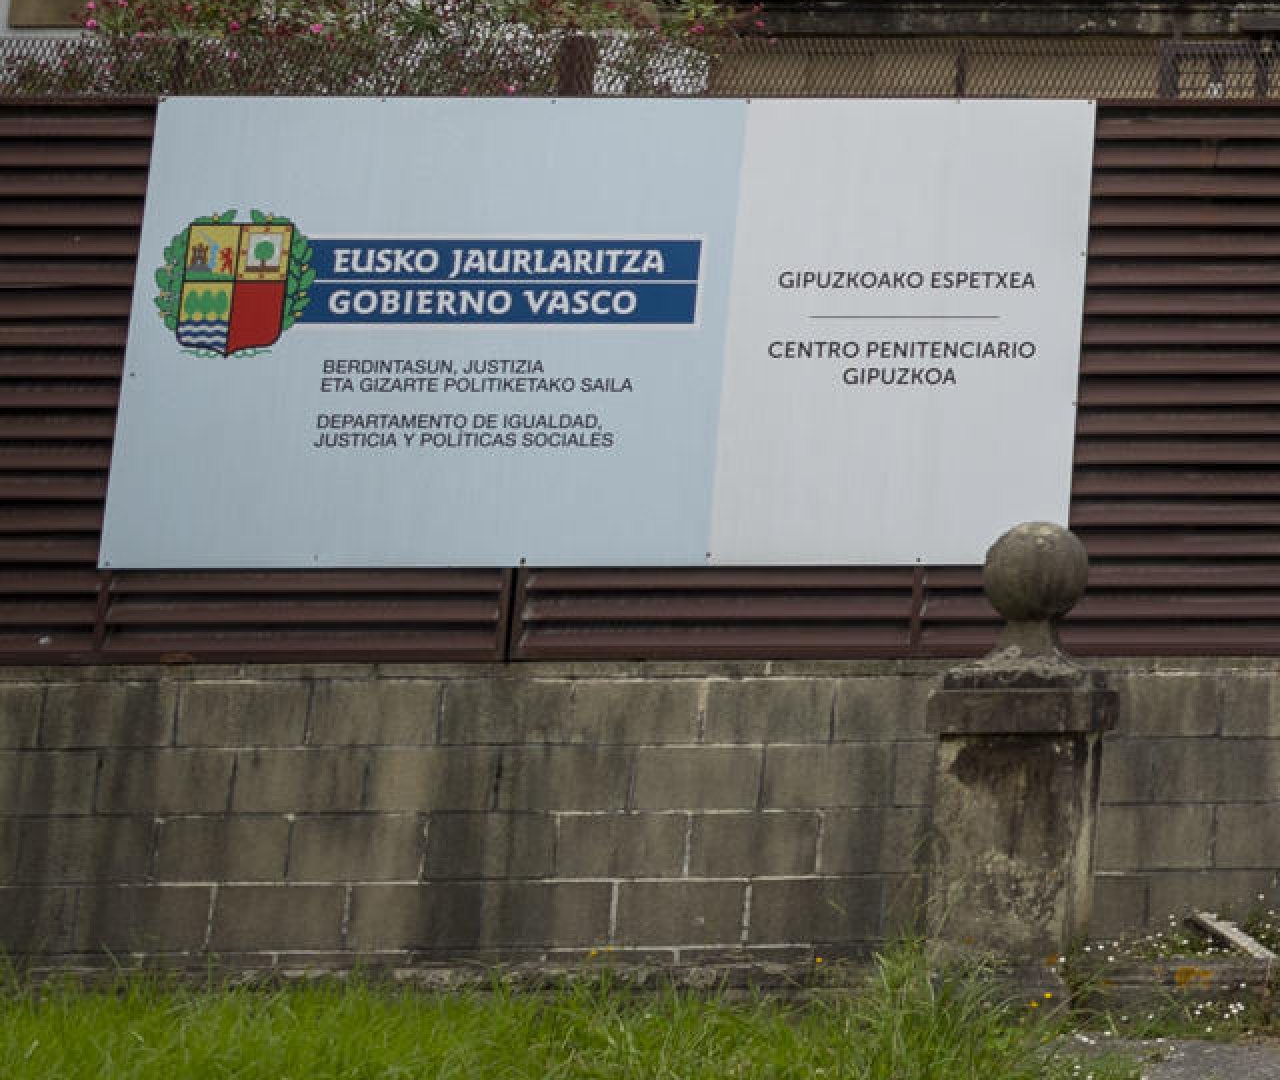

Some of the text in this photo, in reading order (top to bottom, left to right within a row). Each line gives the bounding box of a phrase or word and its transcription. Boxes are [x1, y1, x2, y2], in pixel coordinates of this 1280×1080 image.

[333, 249, 665, 278] EUSKO JAURLARITZA
[779, 272, 1035, 289] GIPUZKOAKO ESPETXEA
[329, 290, 637, 314] GOBIERNO VASCO
[768, 341, 1036, 358] CENTRO PENITENCIARIO
[323, 360, 544, 376] BERDINTASUN, JUSTIZIA
[843, 368, 956, 384] GIPUZKOA
[320, 378, 633, 393] ETA GIZARTE POLITIKETAKO SAILA
[317, 414, 602, 431] DEPARTAMENTO DE IGUALDAD,
[314, 428, 614, 447] JUSTICIA Y POLÍTICAS SOCIALES
